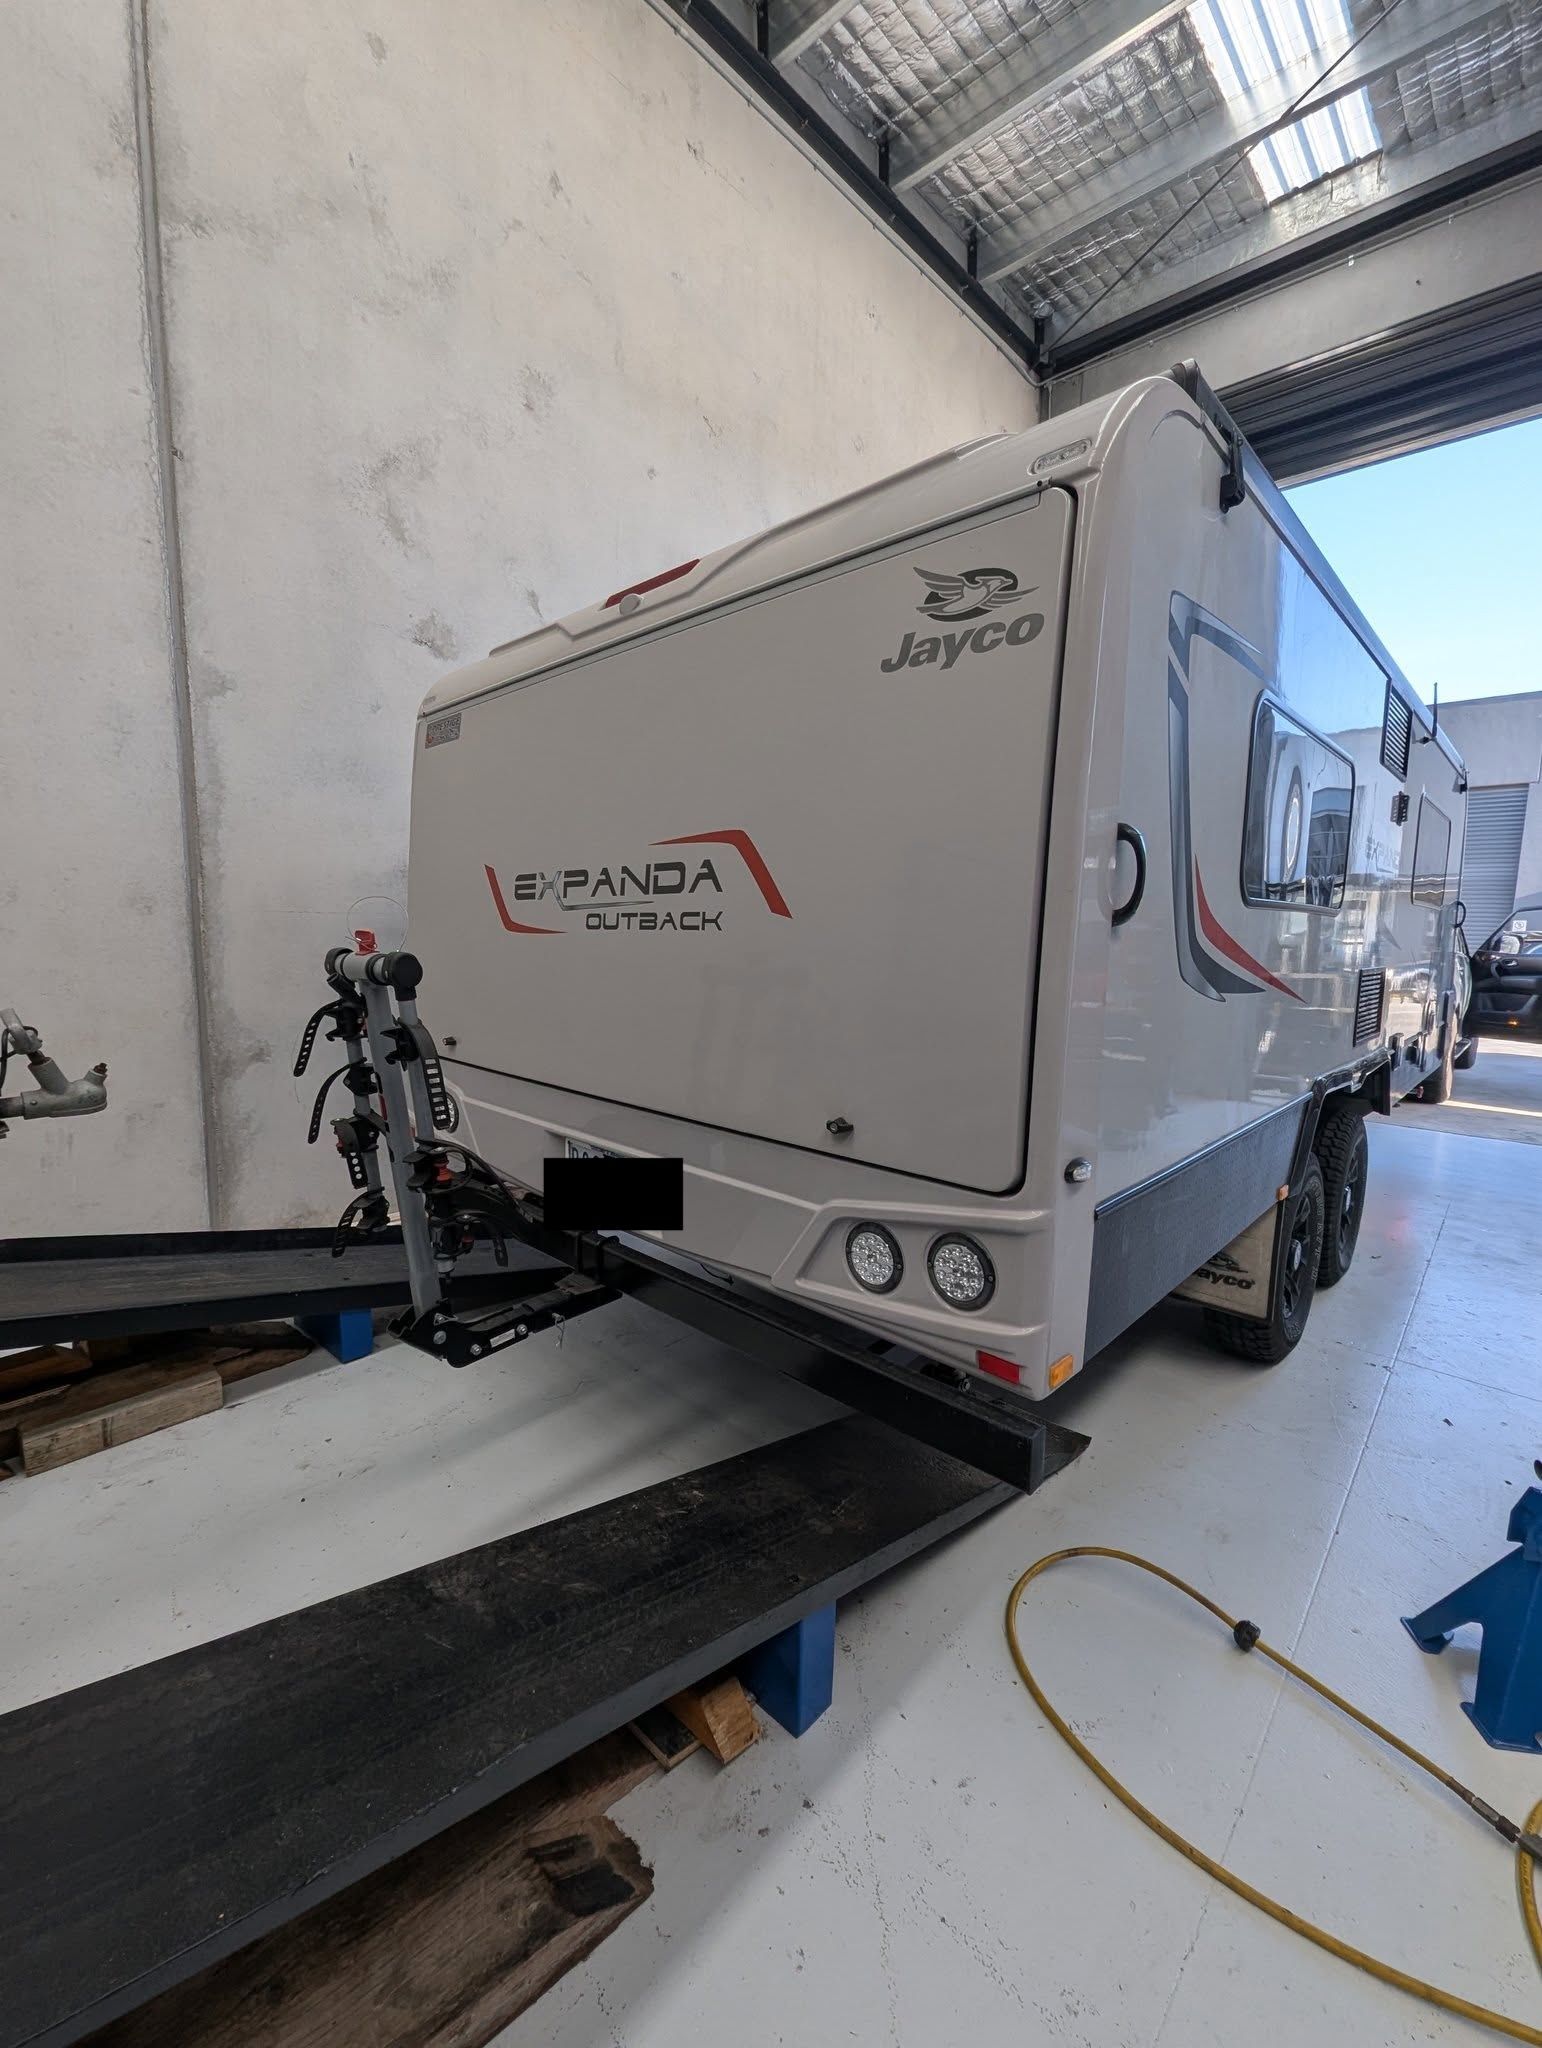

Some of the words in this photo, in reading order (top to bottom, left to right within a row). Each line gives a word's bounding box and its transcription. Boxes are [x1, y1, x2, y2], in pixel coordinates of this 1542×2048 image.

[880, 613, 1045, 673] Jayco
[514, 859, 723, 902] EXPANDA
[585, 911, 723, 931] OUTBACK
[1197, 1268, 1253, 1290] ayco
